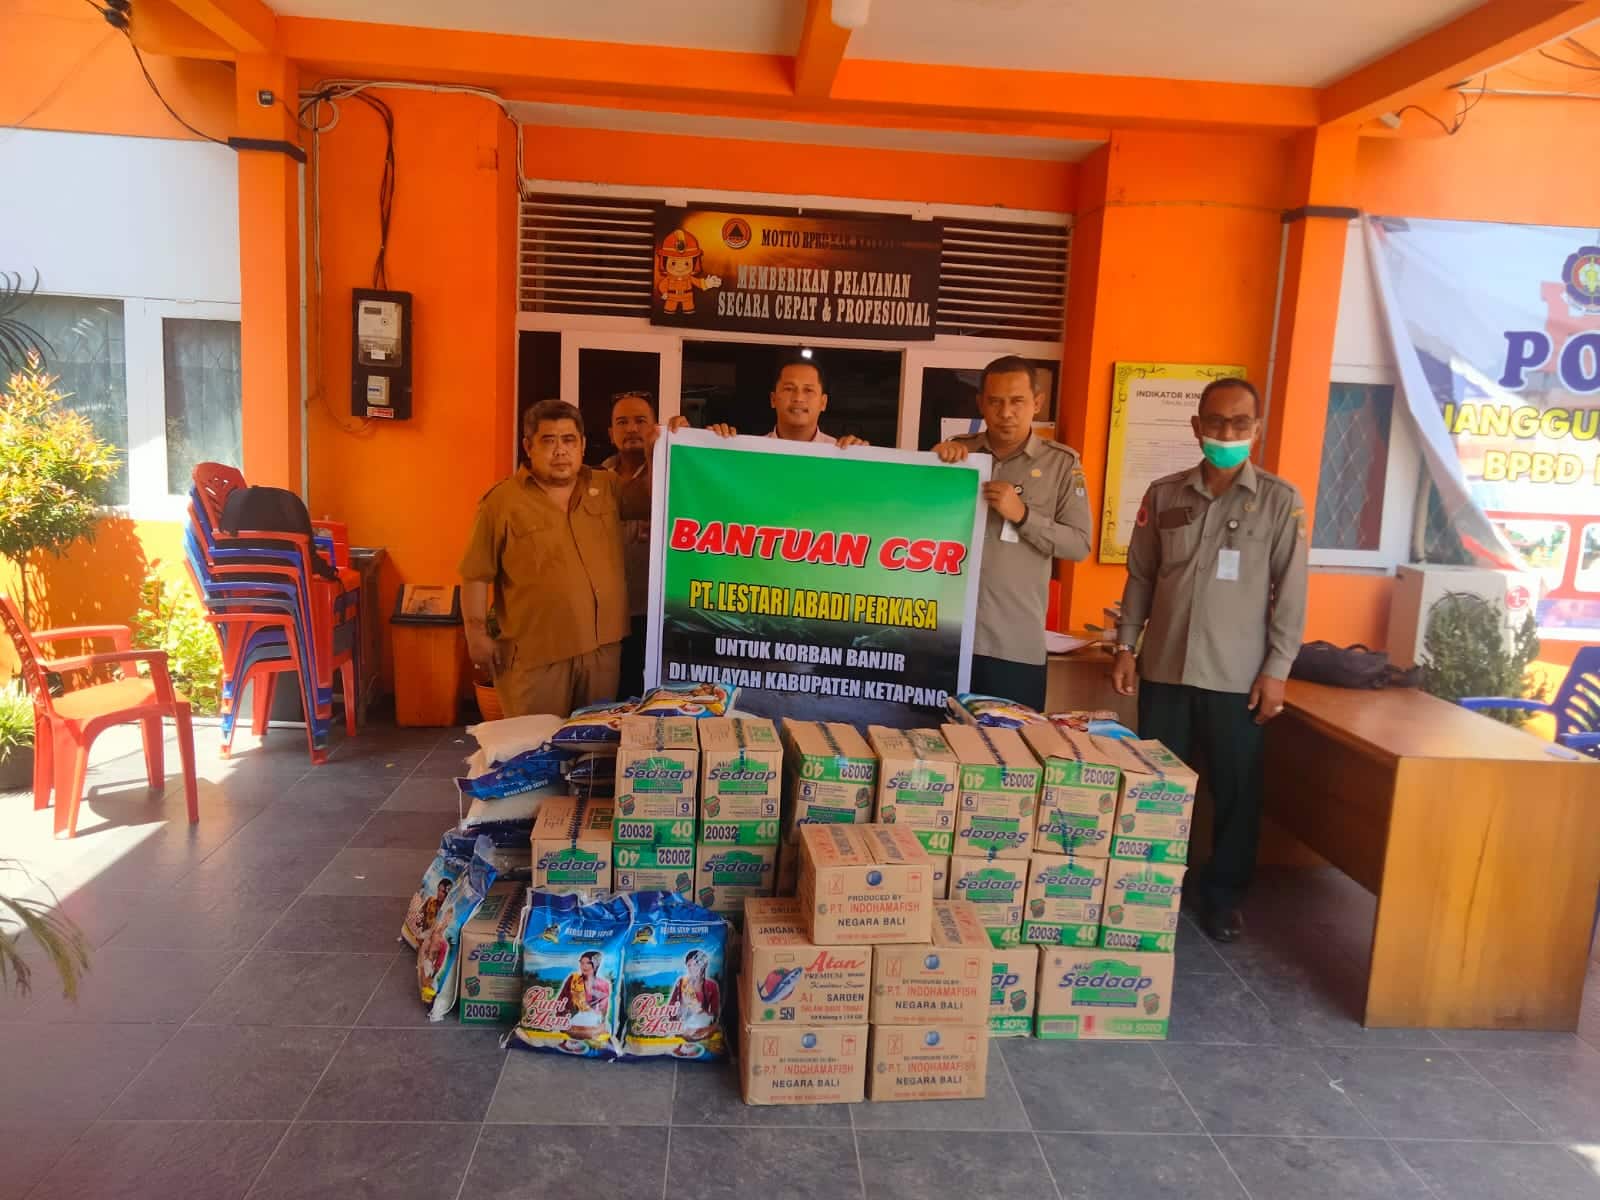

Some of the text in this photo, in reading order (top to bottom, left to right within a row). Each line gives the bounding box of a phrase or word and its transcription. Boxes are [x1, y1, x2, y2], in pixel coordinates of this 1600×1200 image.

[761, 229, 800, 249] MOTTO
[737, 265, 911, 299] MEMBERIKAN PELAYANAN
[718, 291, 930, 328] SECARA CEPAT & PROFESIONAL
[1136, 391, 1184, 400] INDIKATOR
[1484, 450, 1583, 485] BPBD
[671, 519, 966, 573] BANTUAN CSR
[690, 580, 938, 632] PT. LESTARI ABADI PERKASA
[715, 639, 905, 673] UNTUK KORBAN BANJIR
[669, 662, 948, 710] DI WILAYAH KABUPATEN KETAPANG
[623, 766, 693, 781] Sedaap
[709, 766, 776, 782] Sedaap
[802, 761, 824, 778] 40
[1046, 767, 1065, 781] 40
[1083, 768, 1116, 784] 20032
[887, 777, 955, 793] Seap
[964, 773, 984, 788] 40
[1127, 788, 1195, 802] Sedaap
[680, 802, 690, 813] 9
[766, 803, 774, 814] 9
[940, 815, 949, 826] 9
[1179, 823, 1187, 833] 9
[619, 823, 653, 840] 20032
[672, 822, 693, 838] 40
[705, 824, 738, 840] 20032
[756, 821, 777, 838] 40
[959, 828, 1027, 843] Sedaap
[1038, 823, 1107, 841] Sedaap
[927, 831, 949, 849] 40
[658, 847, 691, 865] 20032
[1117, 842, 1148, 855] 20032
[1166, 842, 1187, 857] 40
[618, 849, 640, 866] 40
[536, 858, 606, 873] Sedaap
[702, 860, 771, 875] Sedaap
[955, 878, 1022, 891] Sedaap
[1034, 871, 1103, 887] Sedaap
[1113, 878, 1182, 895] Sedaap
[847, 894, 890, 902] PRODUCED
[850, 902, 920, 913] INDOHAMAFISH
[1088, 909, 1097, 920] 9
[838, 917, 905, 927] NEGARA BALI
[1011, 911, 1018, 922] 9
[759, 927, 795, 935] JANGAN
[1002, 929, 1020, 943] 40
[1029, 926, 1060, 942] 20032
[1076, 925, 1097, 940] 40
[1106, 932, 1139, 948] 20032
[468, 950, 516, 962] Seda
[1058, 973, 1152, 992] Sedaap
[827, 993, 865, 1002] SARDEN
[907, 987, 977, 998] INDOHAMAFISH
[466, 1004, 499, 1019] 20032
[779, 1006, 795, 1020] SNI
[895, 1001, 963, 1010] NEGARA BALI
[784, 1064, 854, 1076] INDOHAMAFISH
[907, 1062, 977, 1073] INDOHAMAFISH
[772, 1079, 840, 1089] NEGARA BALI
[896, 1075, 962, 1086] NEGARA BALI
